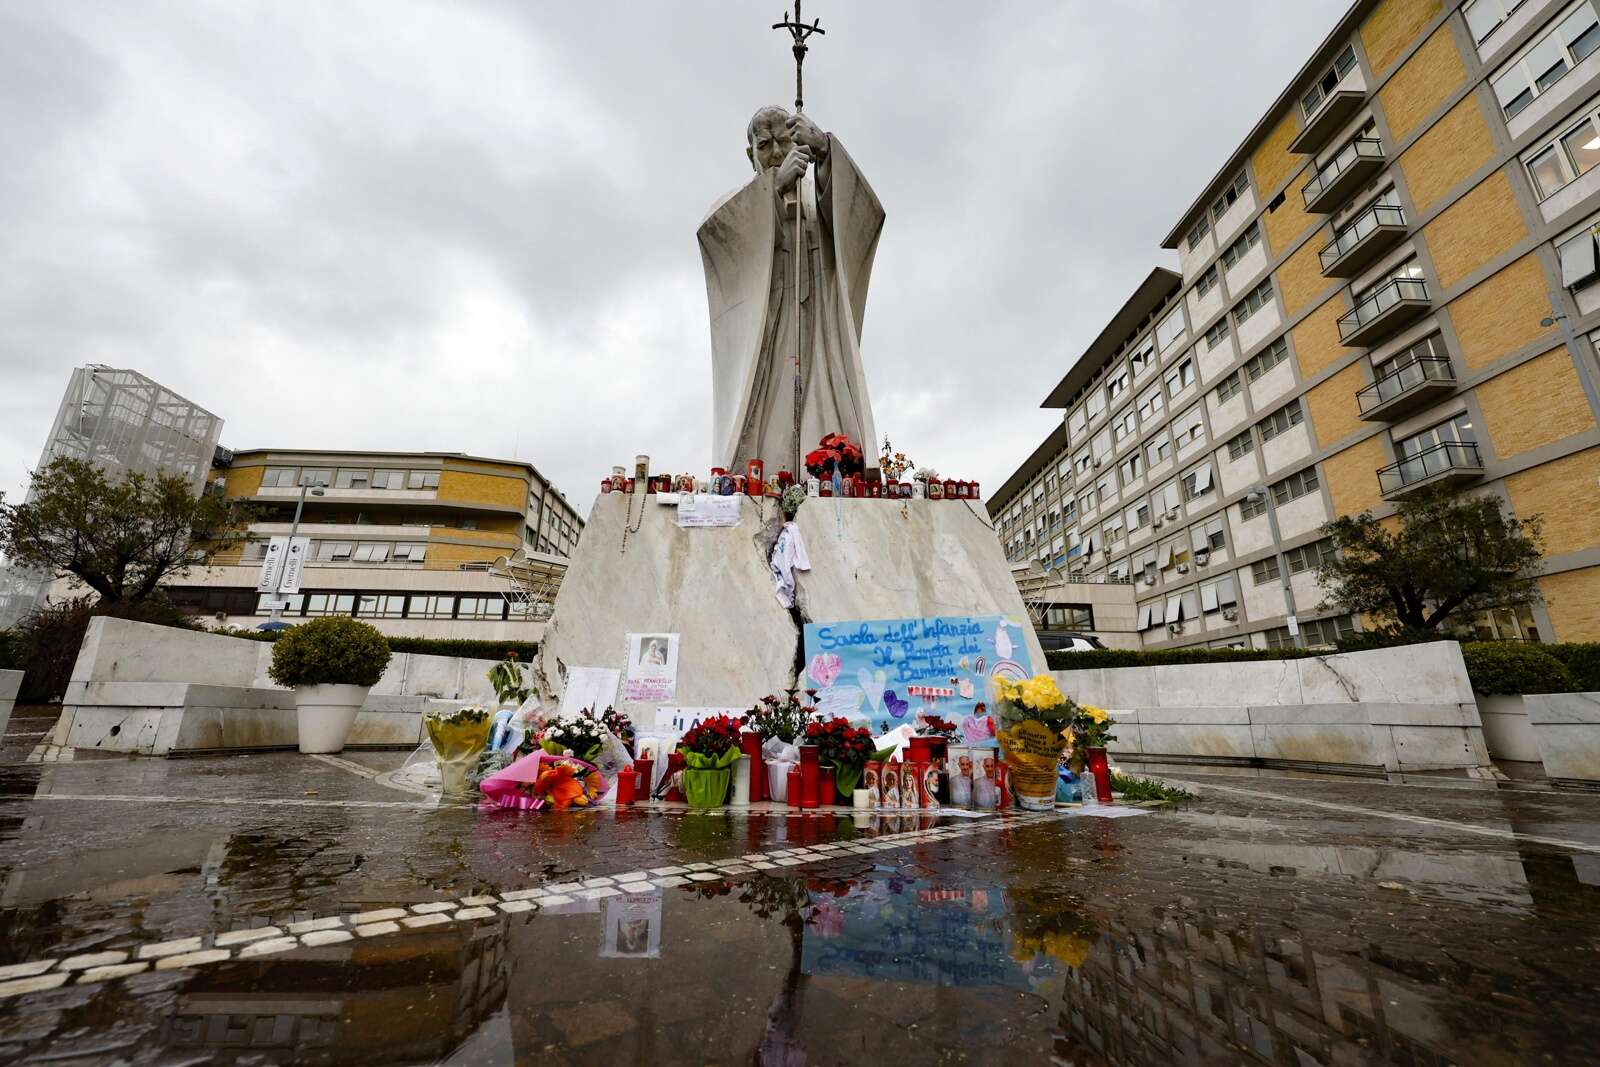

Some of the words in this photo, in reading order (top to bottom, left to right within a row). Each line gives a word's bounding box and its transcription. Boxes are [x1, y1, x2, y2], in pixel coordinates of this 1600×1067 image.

[262, 557, 277, 587] Gemelli
[922, 618, 985, 640] Infanzia
[958, 638, 981, 654] dei
